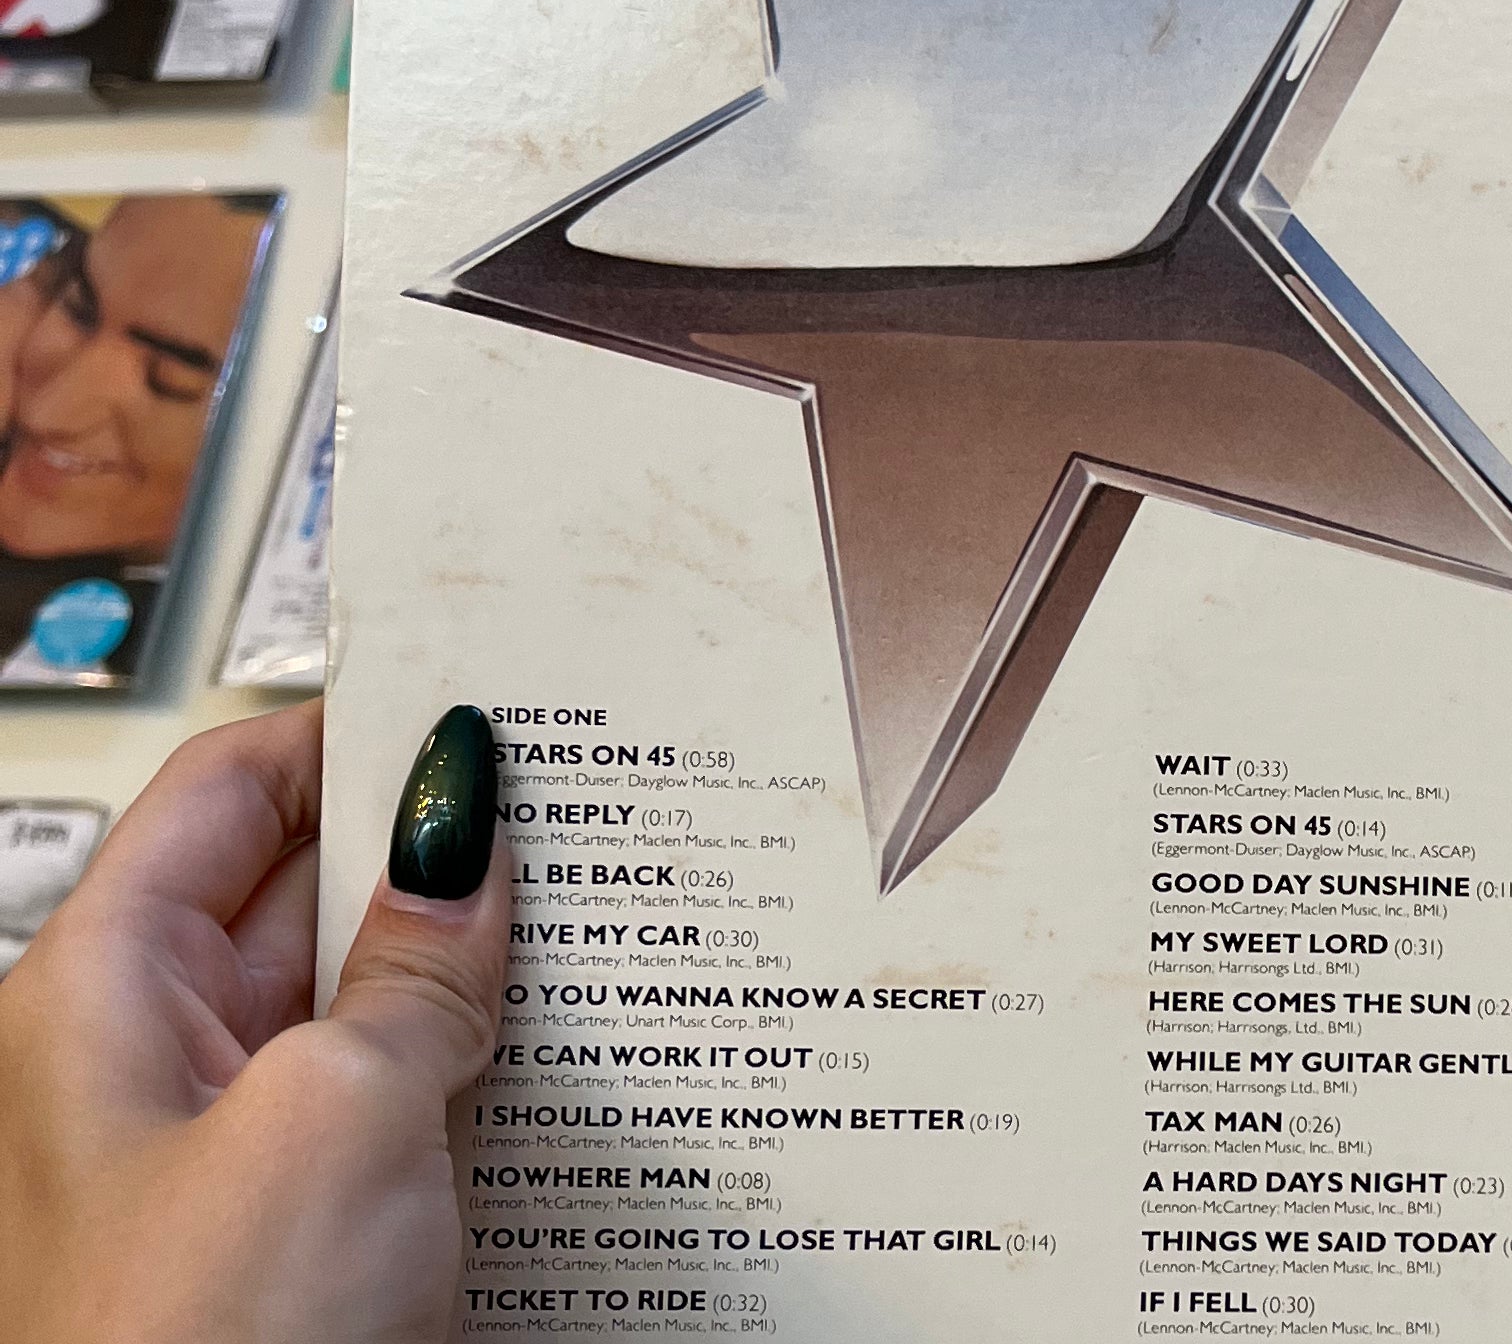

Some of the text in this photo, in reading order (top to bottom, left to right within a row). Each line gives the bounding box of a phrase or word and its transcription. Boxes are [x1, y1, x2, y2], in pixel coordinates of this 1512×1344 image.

[491, 707, 606, 726] SIDE ONE
[494, 743, 734, 773] STARS ON 45 (0:58)
[1155, 754, 1288, 782] WAIT (0:33)
[1294, 785, 1340, 799] Maclen
[495, 802, 692, 831] NO REPLY (0:17)
[510, 923, 758, 952] RIVE MY CAR (0:30)
[1149, 990, 1223, 1013] HERE
[1233, 991, 1336, 1014] COMES
[1343, 992, 1402, 1015] THE
[1410, 993, 1470, 1016] SUN
[534, 1044, 600, 1066] CAN
[609, 1045, 702, 1068] WORK
[710, 1046, 738, 1068] IT
[745, 1047, 813, 1068] OUT
[819, 1052, 869, 1074] (0:15)
[1145, 1110, 1340, 1138] TAX MAN (0:26)
